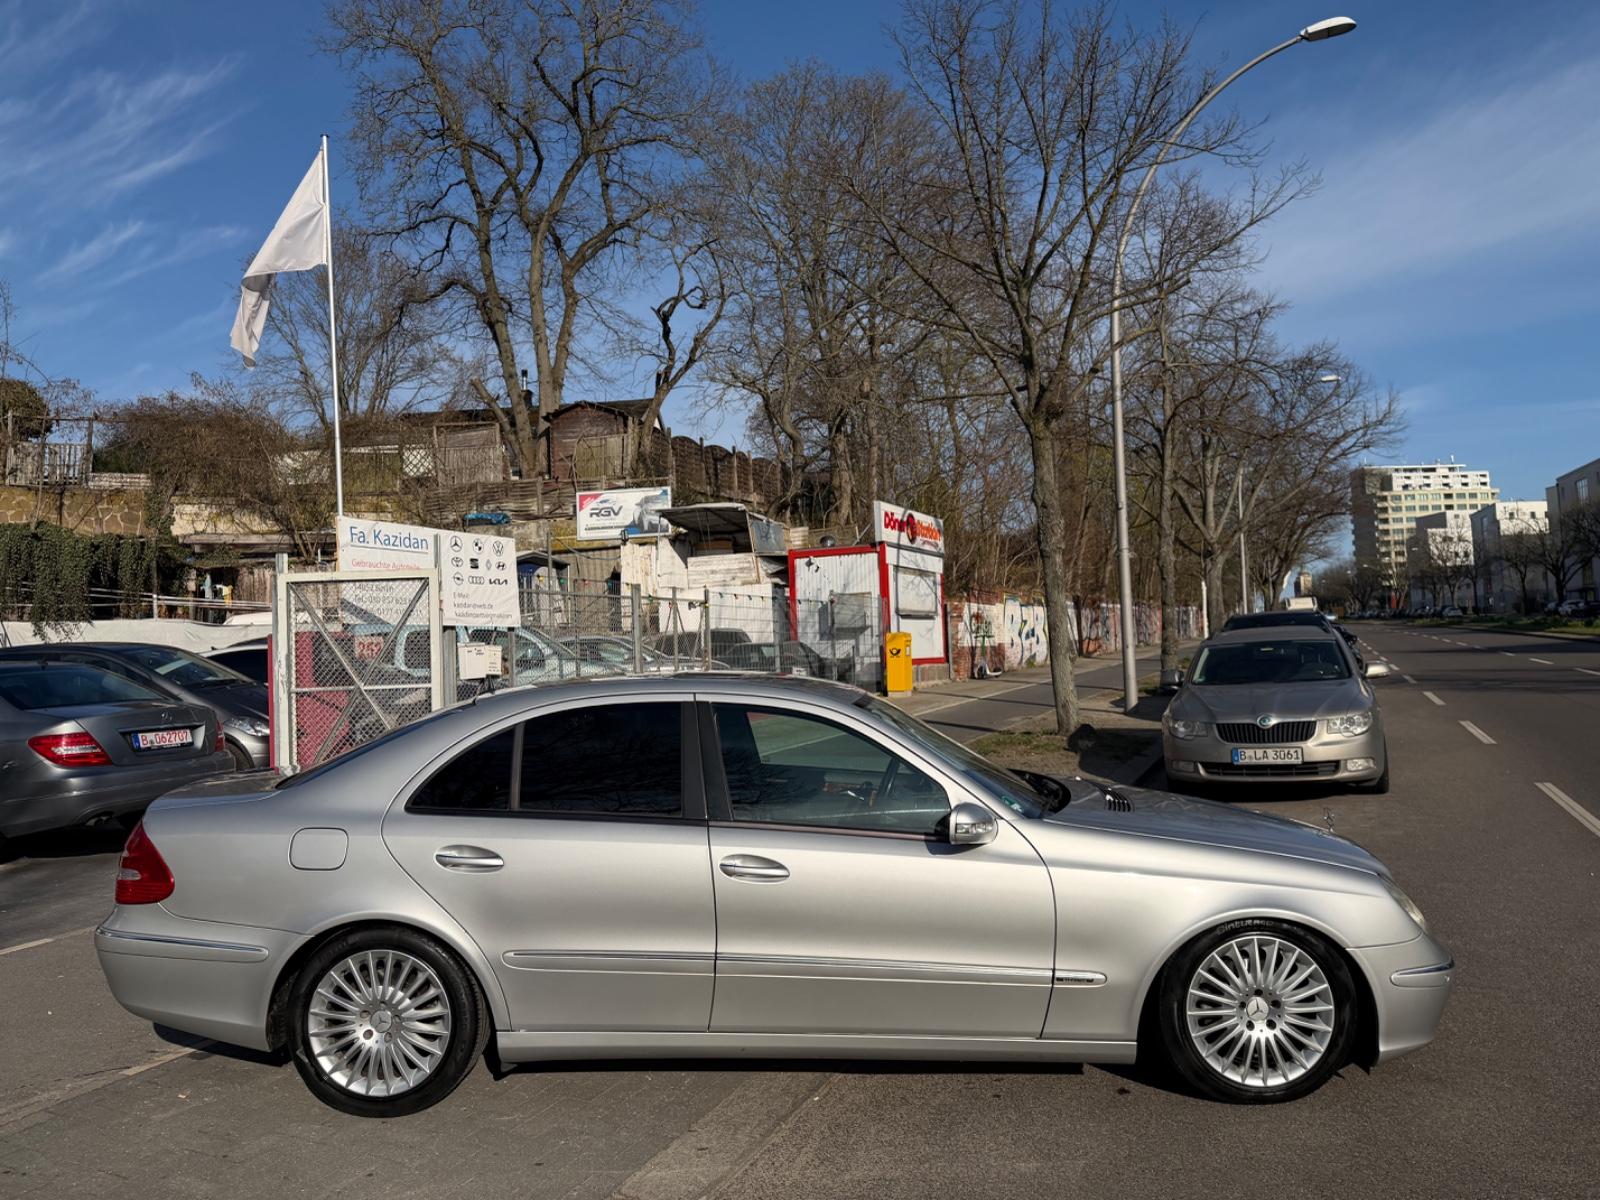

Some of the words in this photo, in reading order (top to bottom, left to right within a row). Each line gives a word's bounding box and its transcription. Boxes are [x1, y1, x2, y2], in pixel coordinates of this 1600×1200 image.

[590, 505, 623, 518] RGV
[349, 526, 369, 544] Fa.
[373, 529, 429, 550] Kazidan
[141, 734, 149, 746] B
[154, 730, 188, 744] 062707
[1239, 750, 1247, 761] B
[1254, 750, 1269, 761] LA
[1272, 750, 1301, 761] 3061
